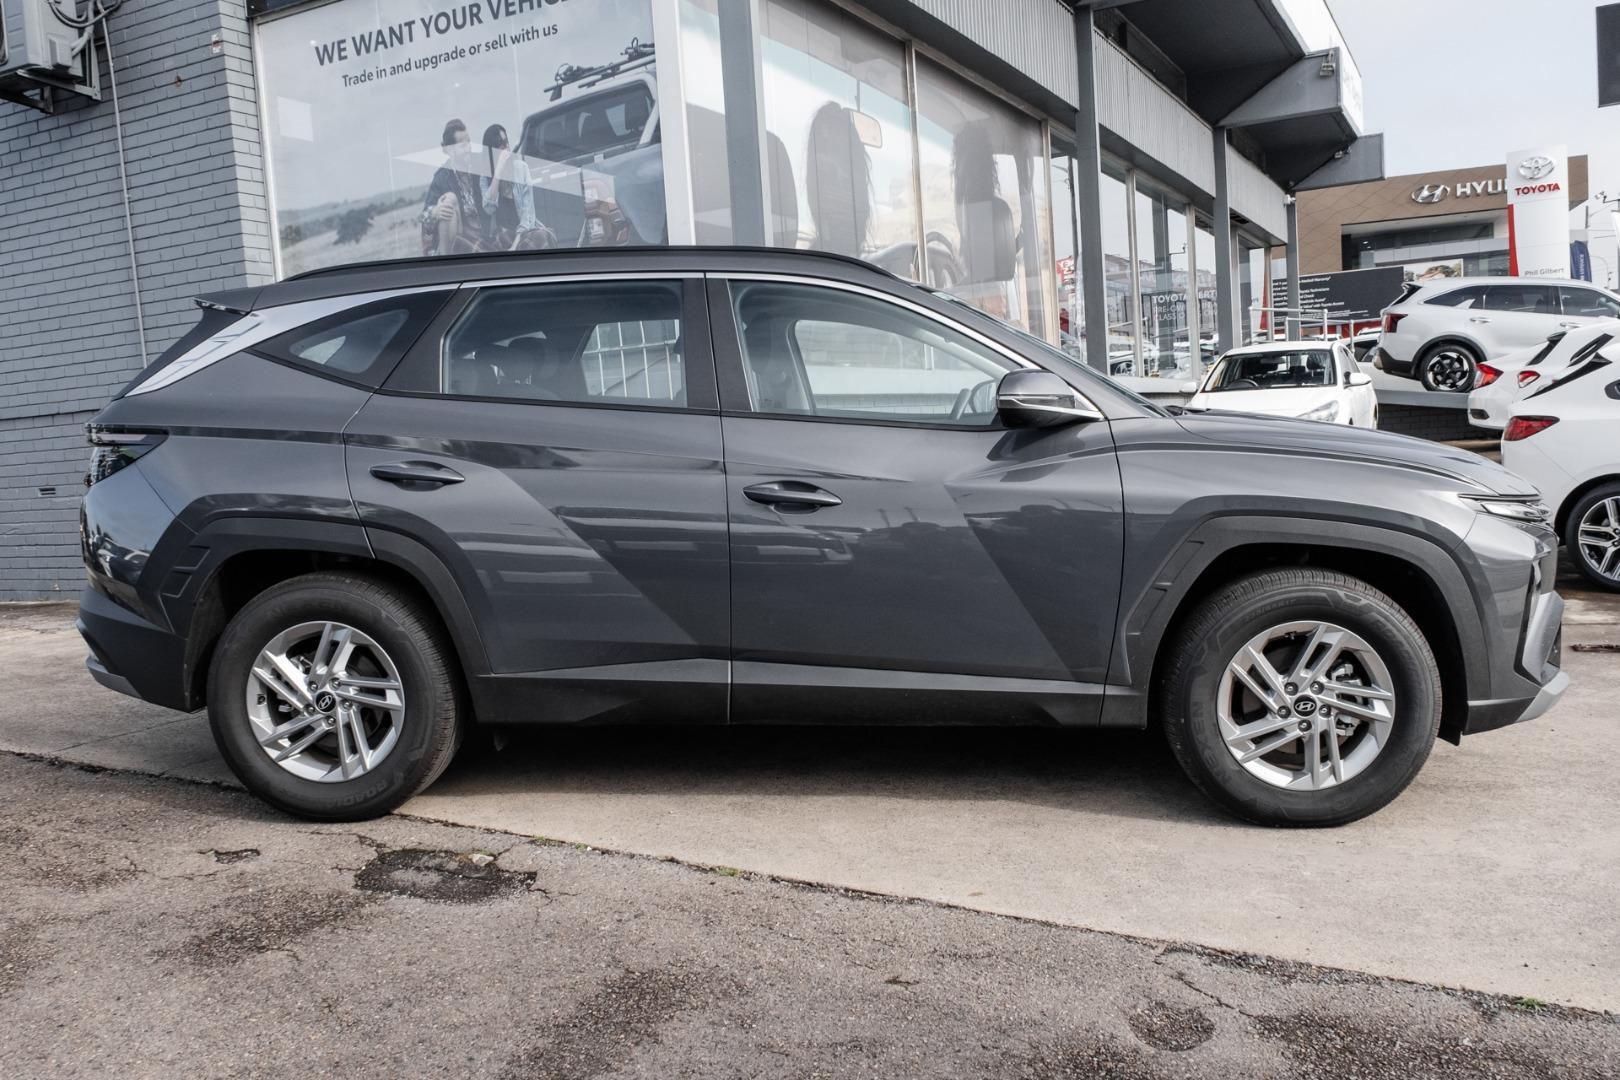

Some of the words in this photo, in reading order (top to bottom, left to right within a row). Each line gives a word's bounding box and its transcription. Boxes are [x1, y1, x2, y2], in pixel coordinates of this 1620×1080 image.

[314, 39, 348, 66] WE
[351, 20, 416, 57] WANT
[420, 2, 484, 38] YOUR
[342, 69, 374, 87] Trade
[375, 66, 387, 79] in
[390, 58, 412, 76] and
[414, 45, 466, 71] upgrade
[468, 43, 482, 55] or
[485, 33, 508, 52] sell
[510, 26, 540, 45] with
[542, 24, 558, 37] us
[1514, 183, 1561, 196] TOYOTA
[1539, 267, 1564, 275] Gilbert
